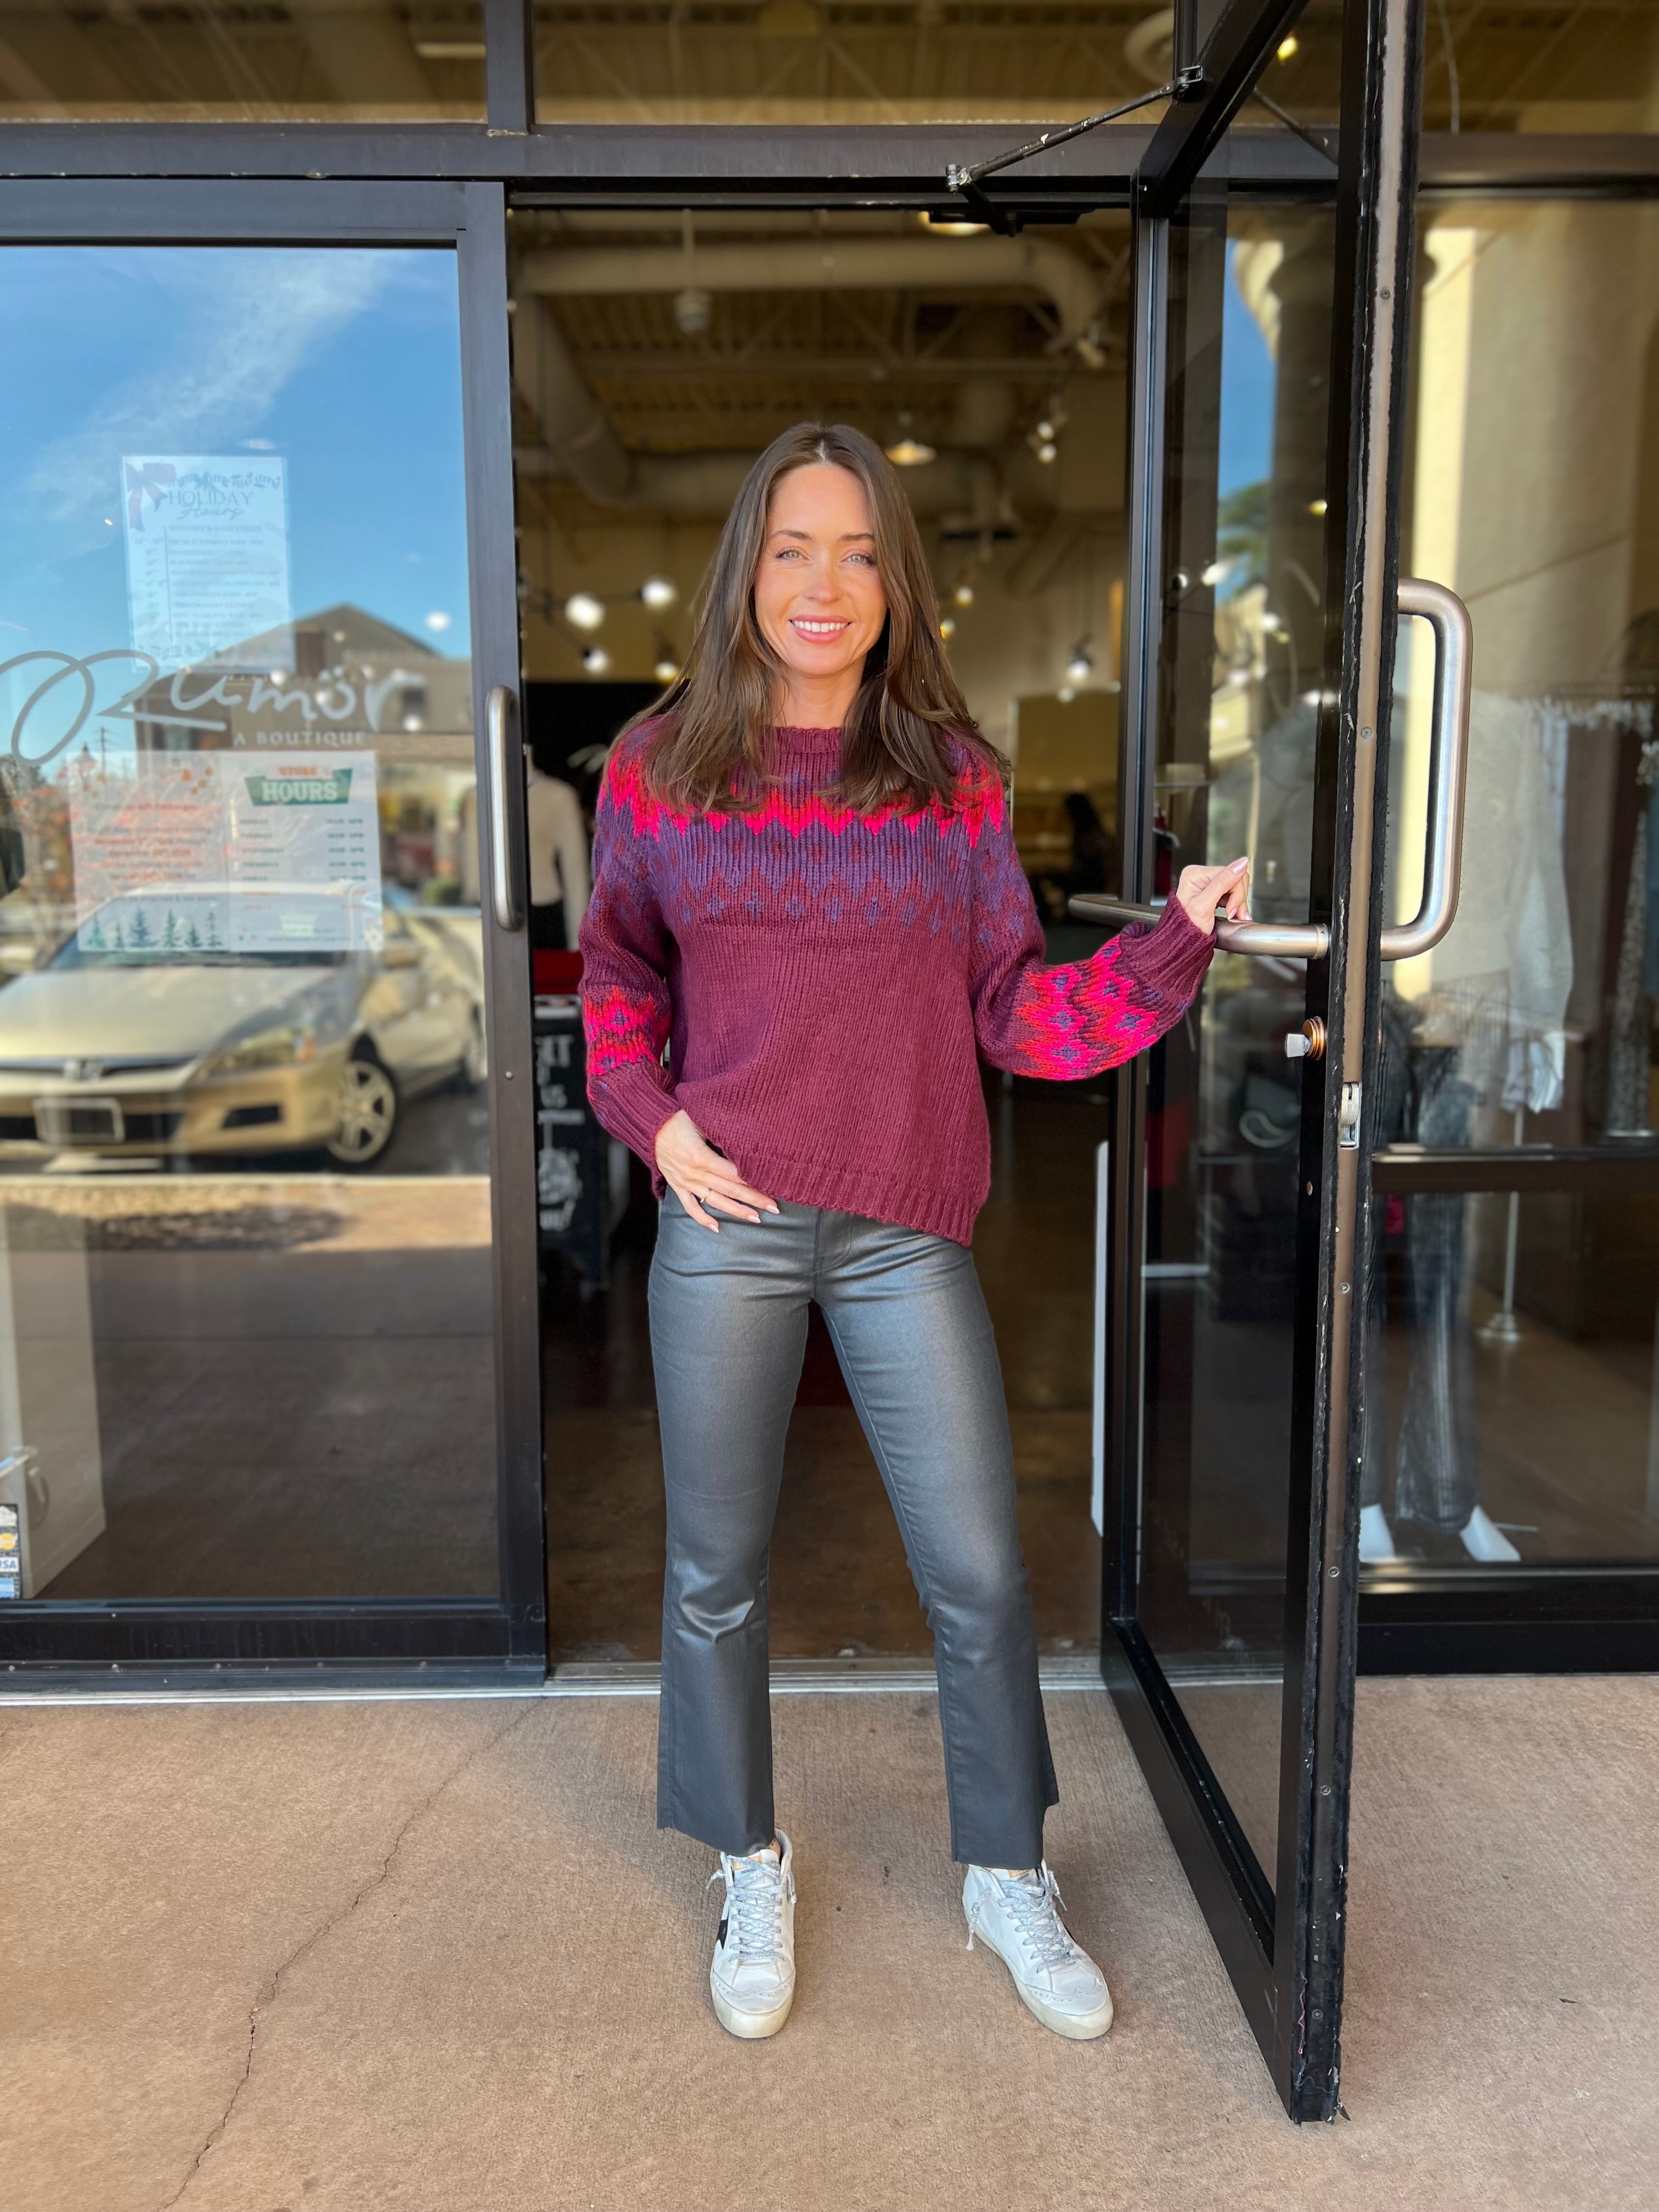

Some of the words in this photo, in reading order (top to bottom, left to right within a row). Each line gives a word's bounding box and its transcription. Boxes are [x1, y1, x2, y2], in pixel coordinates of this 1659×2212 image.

[168, 490, 254, 506] HOLIDAY
[234, 731, 246, 746] A
[256, 730, 366, 748] BOUTIQUE
[279, 766, 318, 776] STORE
[261, 781, 338, 802] HOURS
